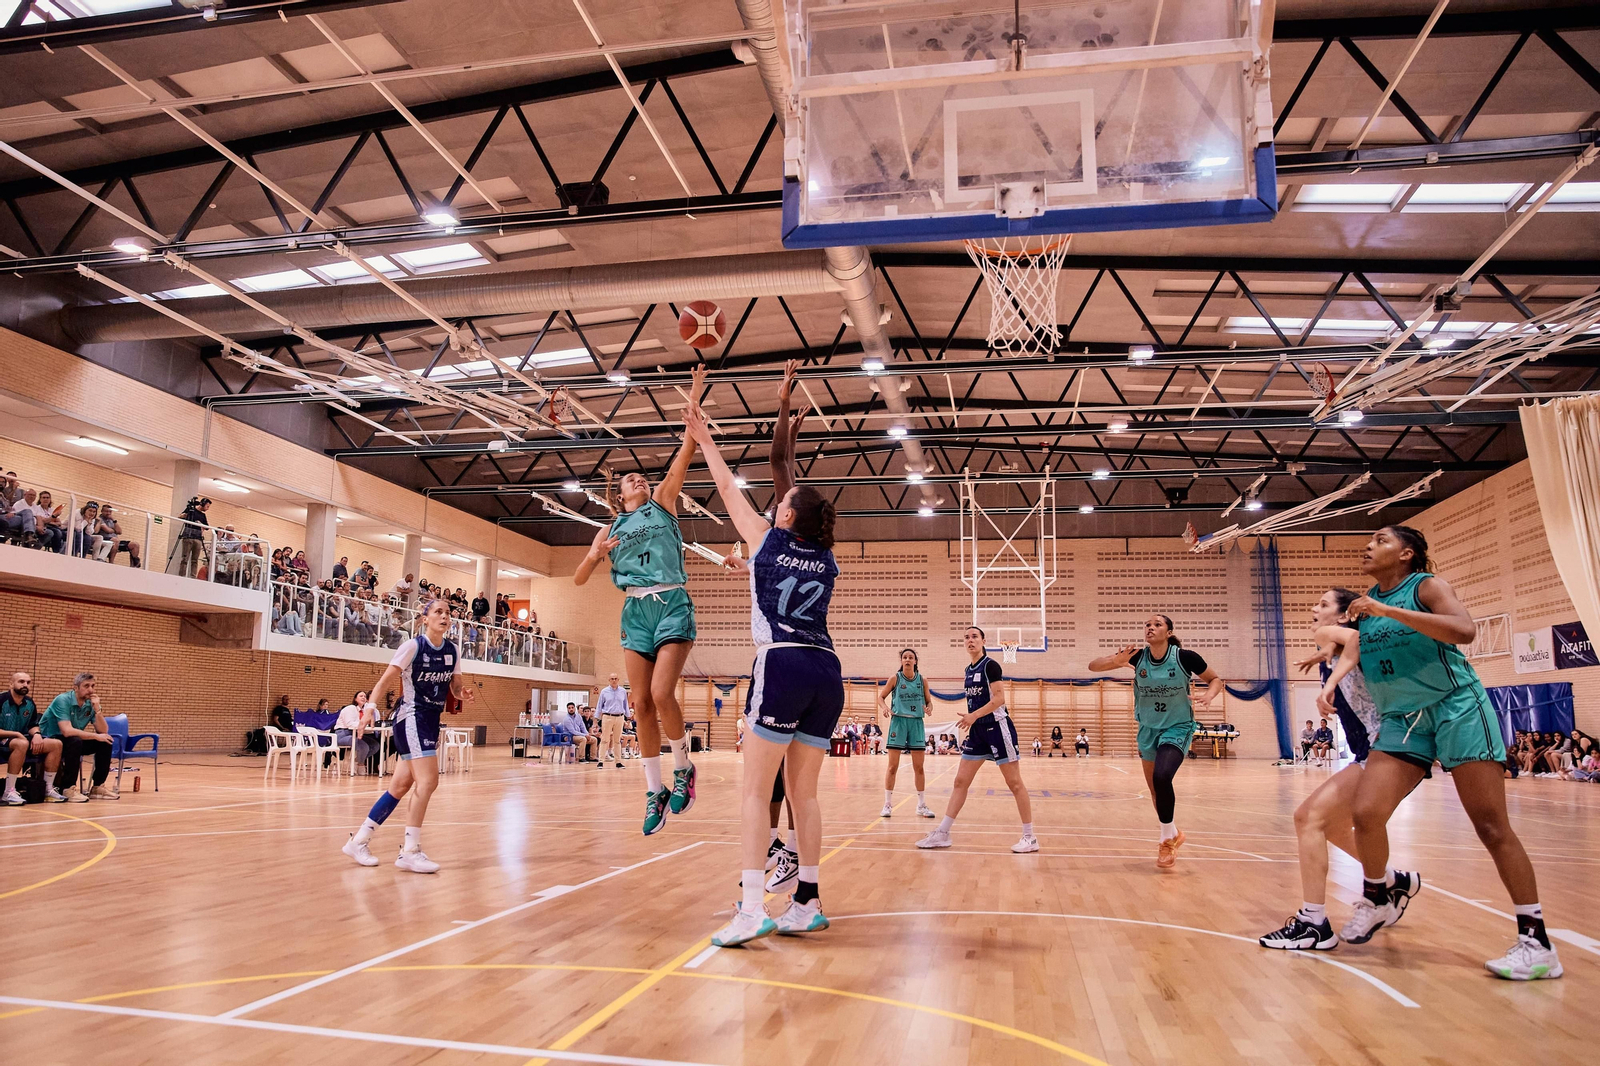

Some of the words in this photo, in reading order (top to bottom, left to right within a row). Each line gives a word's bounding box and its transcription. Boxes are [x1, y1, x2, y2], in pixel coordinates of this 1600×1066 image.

[638, 551, 650, 566] 77
[776, 554, 826, 573] SORIANO
[776, 575, 825, 621] 12
[1560, 640, 1591, 654] ALTAFIT
[1379, 659, 1395, 675] 33
[433, 685, 439, 697] 9
[1154, 702, 1167, 712] 32
